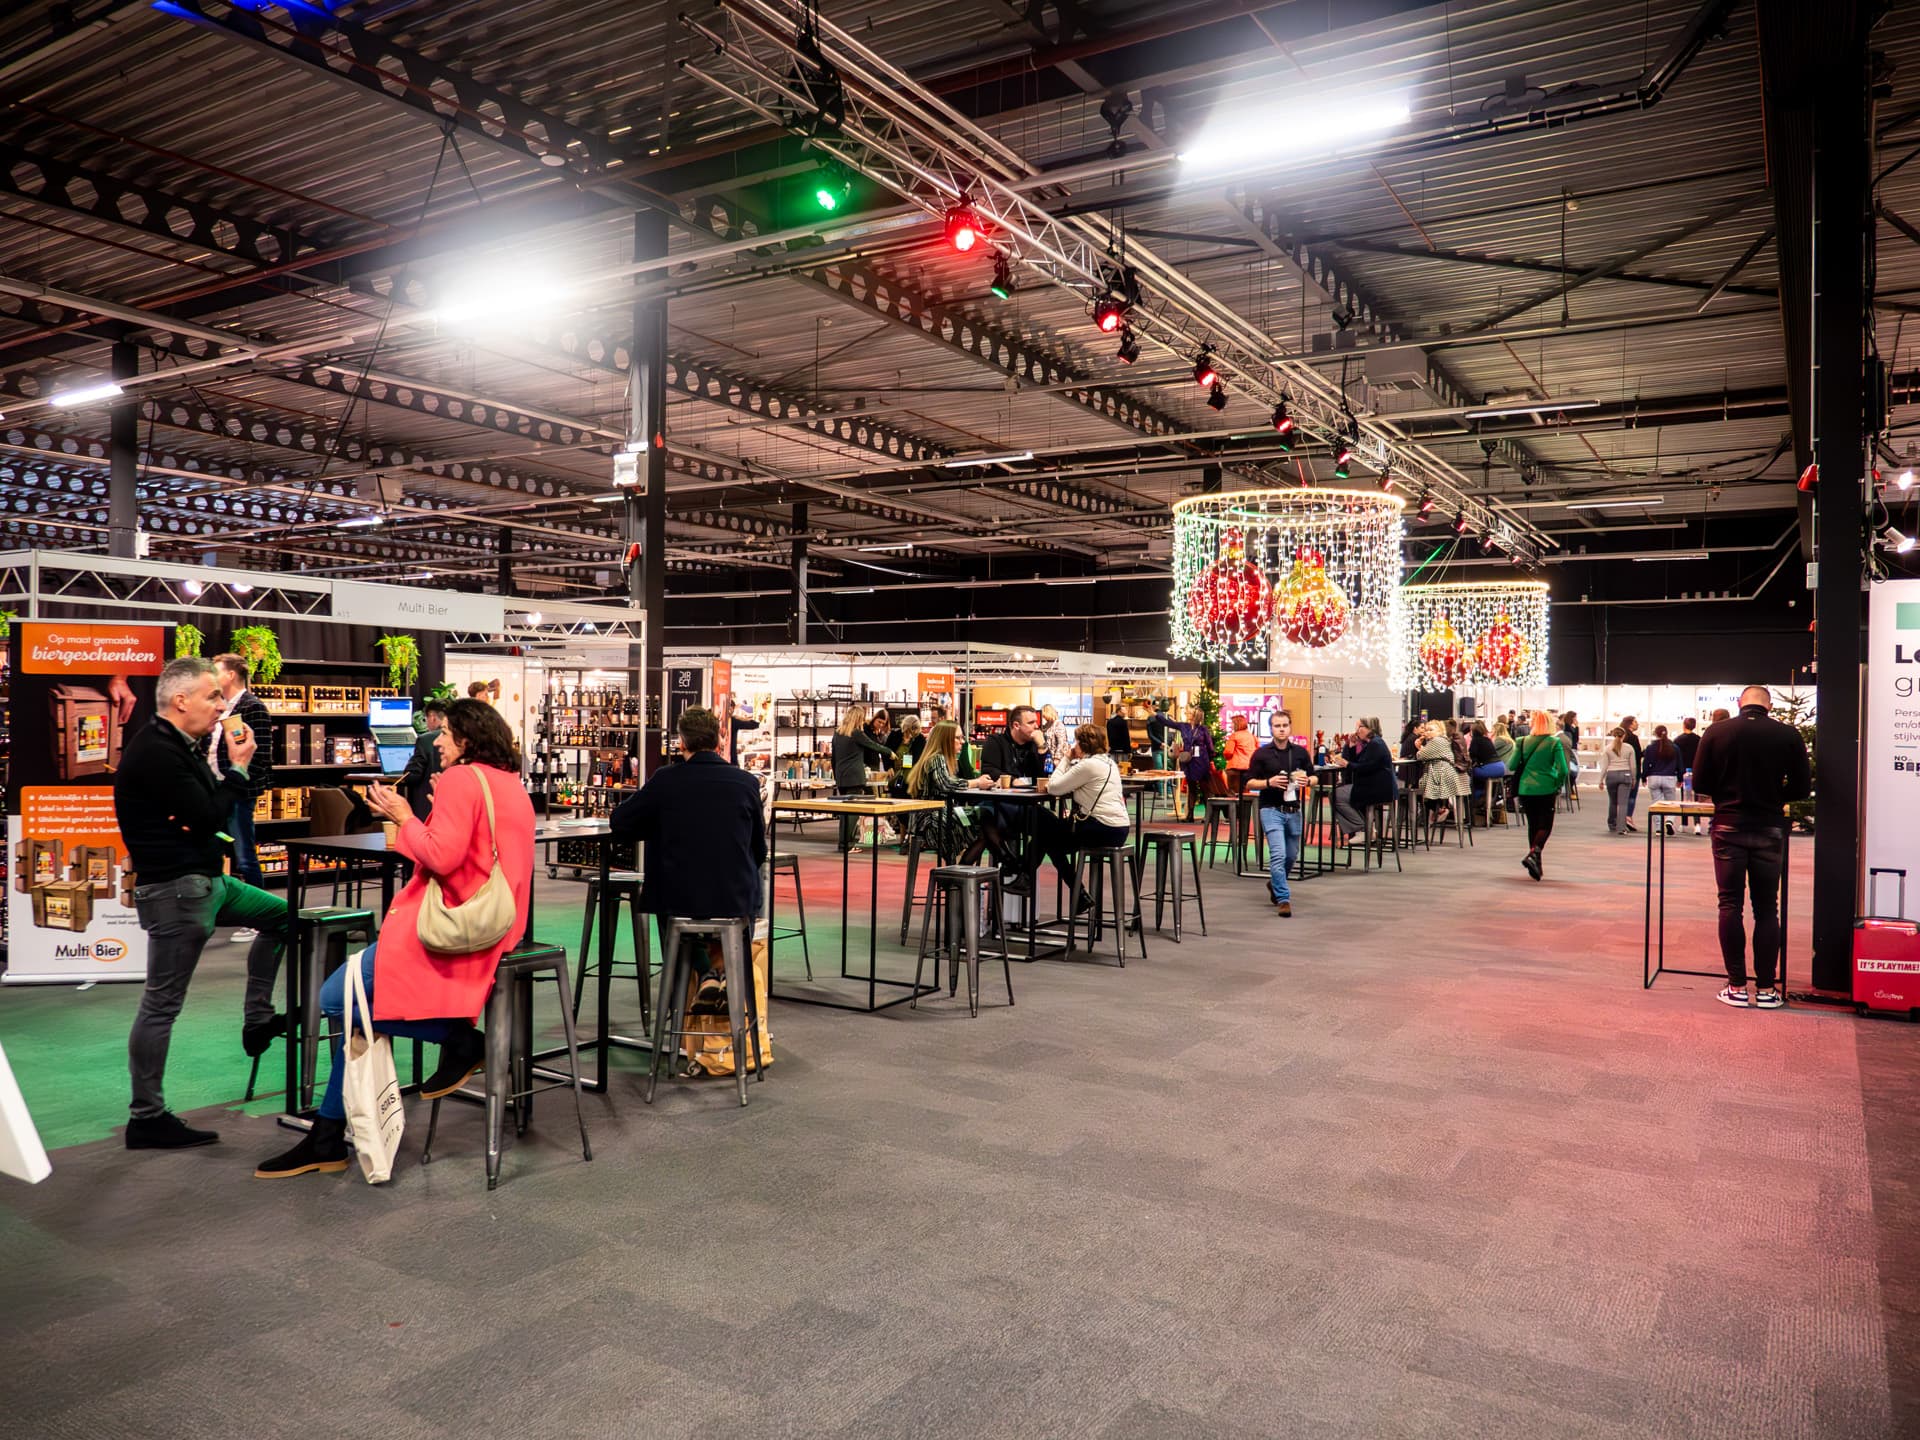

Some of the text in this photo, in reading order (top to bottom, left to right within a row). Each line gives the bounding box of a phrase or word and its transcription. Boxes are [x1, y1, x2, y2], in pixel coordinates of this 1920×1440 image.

[398, 602, 449, 616] Multi Bier
[48, 633, 140, 646] Op maat gemaakte
[32, 645, 157, 666] biergeschenken
[1895, 709, 1920, 717] Pers
[1894, 733, 1920, 742] stijlv
[55, 944, 122, 957] Multi Bier
[1860, 961, 1919, 971] IT'S PLAYTIME!
